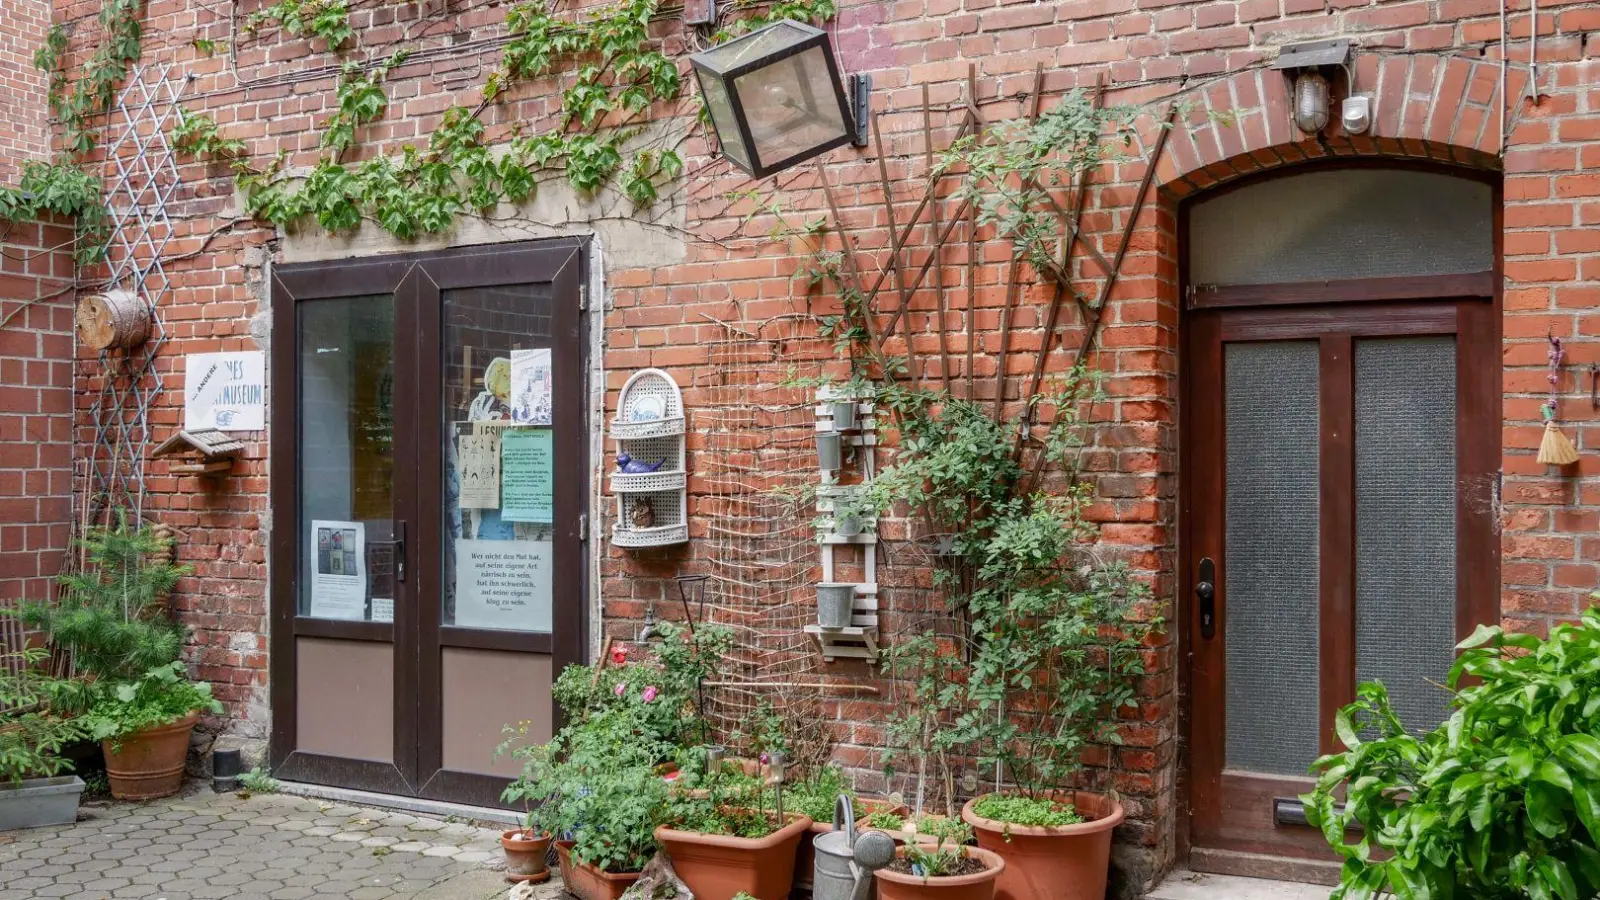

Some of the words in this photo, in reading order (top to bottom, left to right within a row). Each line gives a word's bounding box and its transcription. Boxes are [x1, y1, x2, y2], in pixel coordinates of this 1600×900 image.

[197, 362, 218, 393] ANDERE
[472, 552, 483, 560] Wer
[511, 590, 532, 598] eigene
[486, 598, 500, 606] klug
